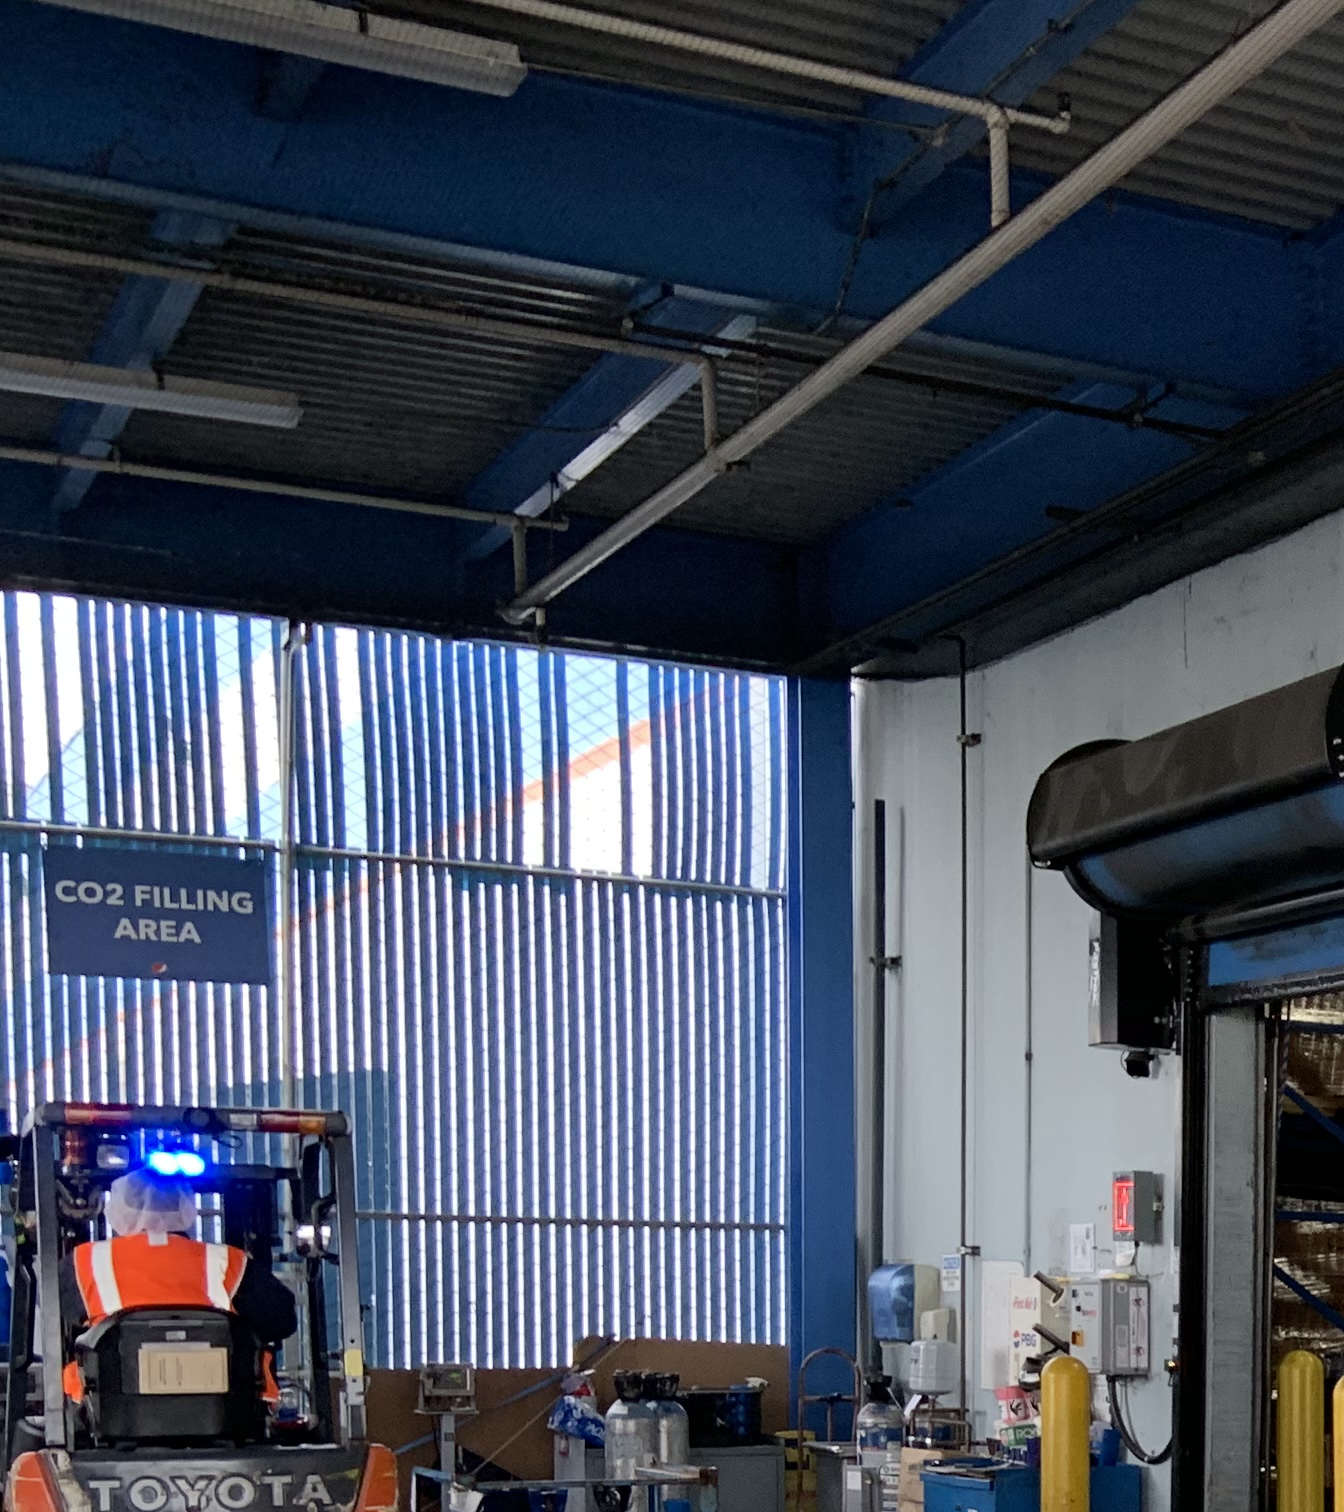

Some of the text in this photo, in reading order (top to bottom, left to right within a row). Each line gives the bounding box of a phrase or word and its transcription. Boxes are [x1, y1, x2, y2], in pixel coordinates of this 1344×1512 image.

[55, 879, 254, 915] CO2 FILLING
[113, 917, 202, 944] AREA
[88, 1474, 333, 1512] TOYOTA
